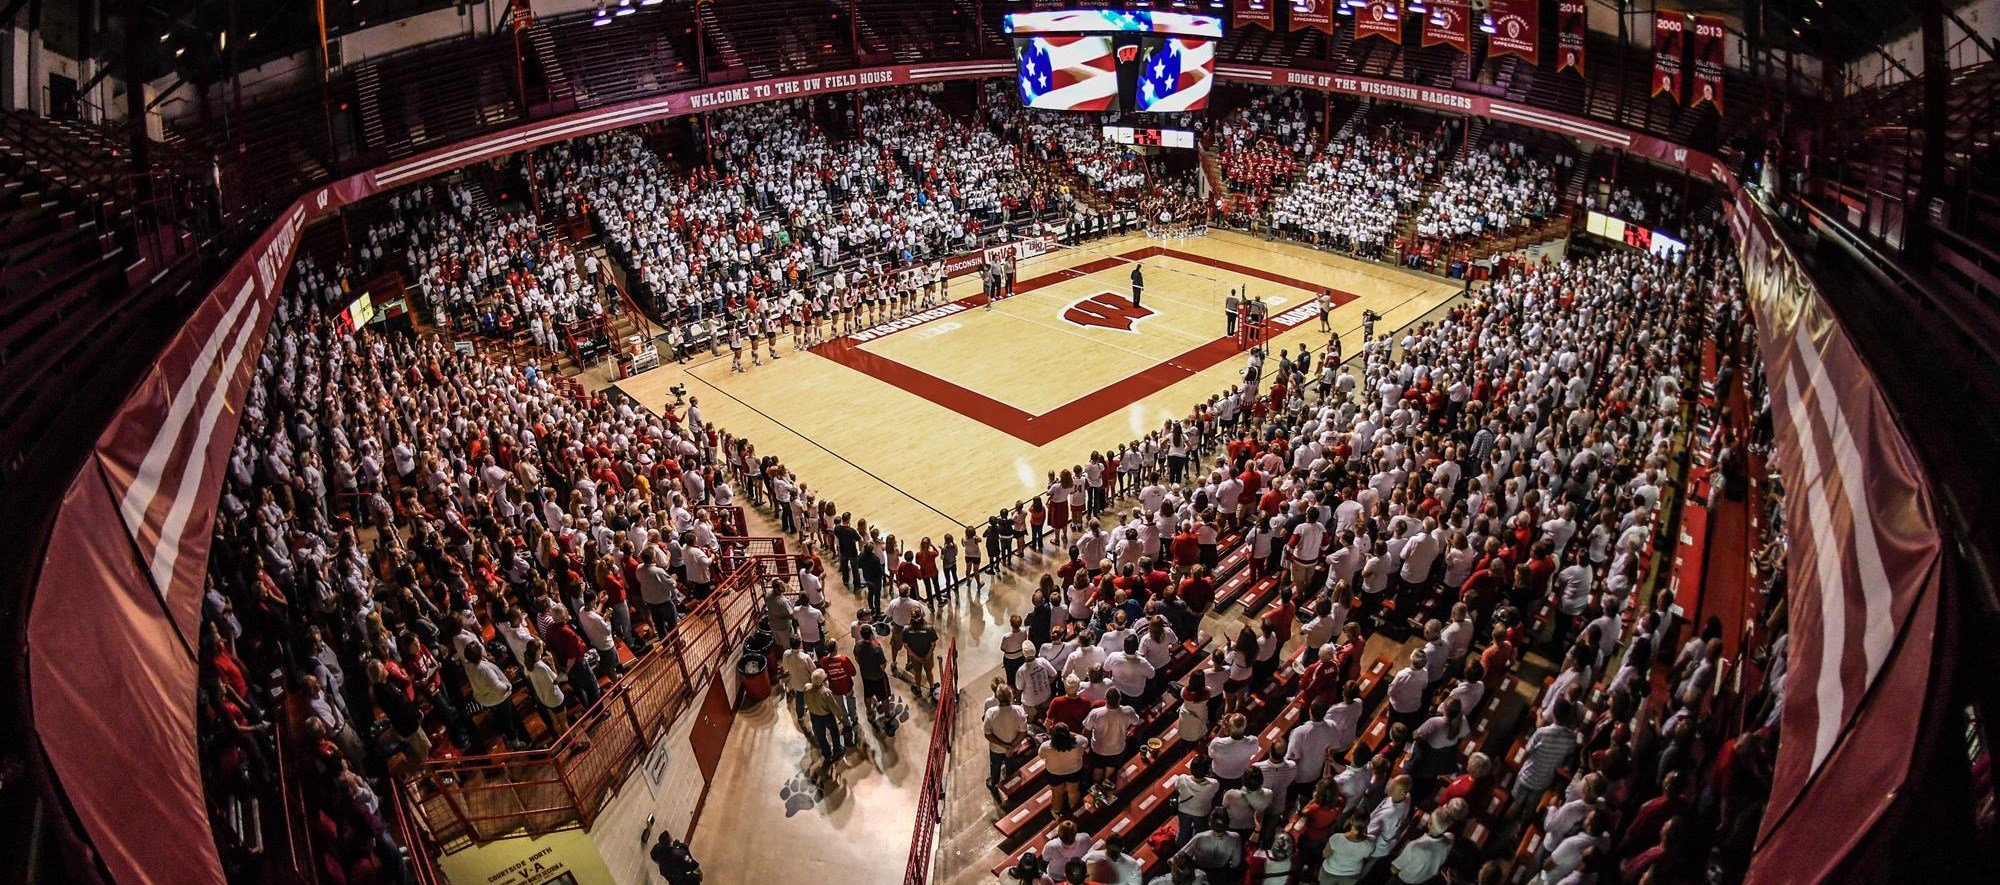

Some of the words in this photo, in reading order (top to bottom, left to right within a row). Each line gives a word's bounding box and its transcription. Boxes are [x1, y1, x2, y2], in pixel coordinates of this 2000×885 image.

[1560, 3, 1583, 14] 2014
[1359, 24, 1396, 32] APPEARANCES
[1497, 14, 1530, 31] VOLLEYBALL
[1656, 19, 1682, 32] 2000
[1427, 32, 1465, 42] APPEARANCES
[1696, 24, 1723, 38] 2013
[1493, 40, 1533, 51] APPEARANCES
[690, 87, 750, 108] WELCOME
[754, 85, 771, 98] TO
[775, 80, 800, 95] THE
[803, 77, 821, 91] UW
[825, 74, 856, 89] FIELD
[860, 70, 893, 84] HOUSE
[1288, 72, 1315, 86] HOME
[1318, 76, 1331, 87] OF
[1335, 78, 1357, 90] THE
[1360, 81, 1418, 100] WISCONSIN
[1421, 90, 1472, 109] BADGERS
[946, 257, 983, 274] WISCONSIN
[847, 303, 968, 342] WISCONSIN
[488, 860, 527, 883] COURTSIDE
[528, 846, 553, 862] NORTH
[518, 862, 545, 878] V-A
